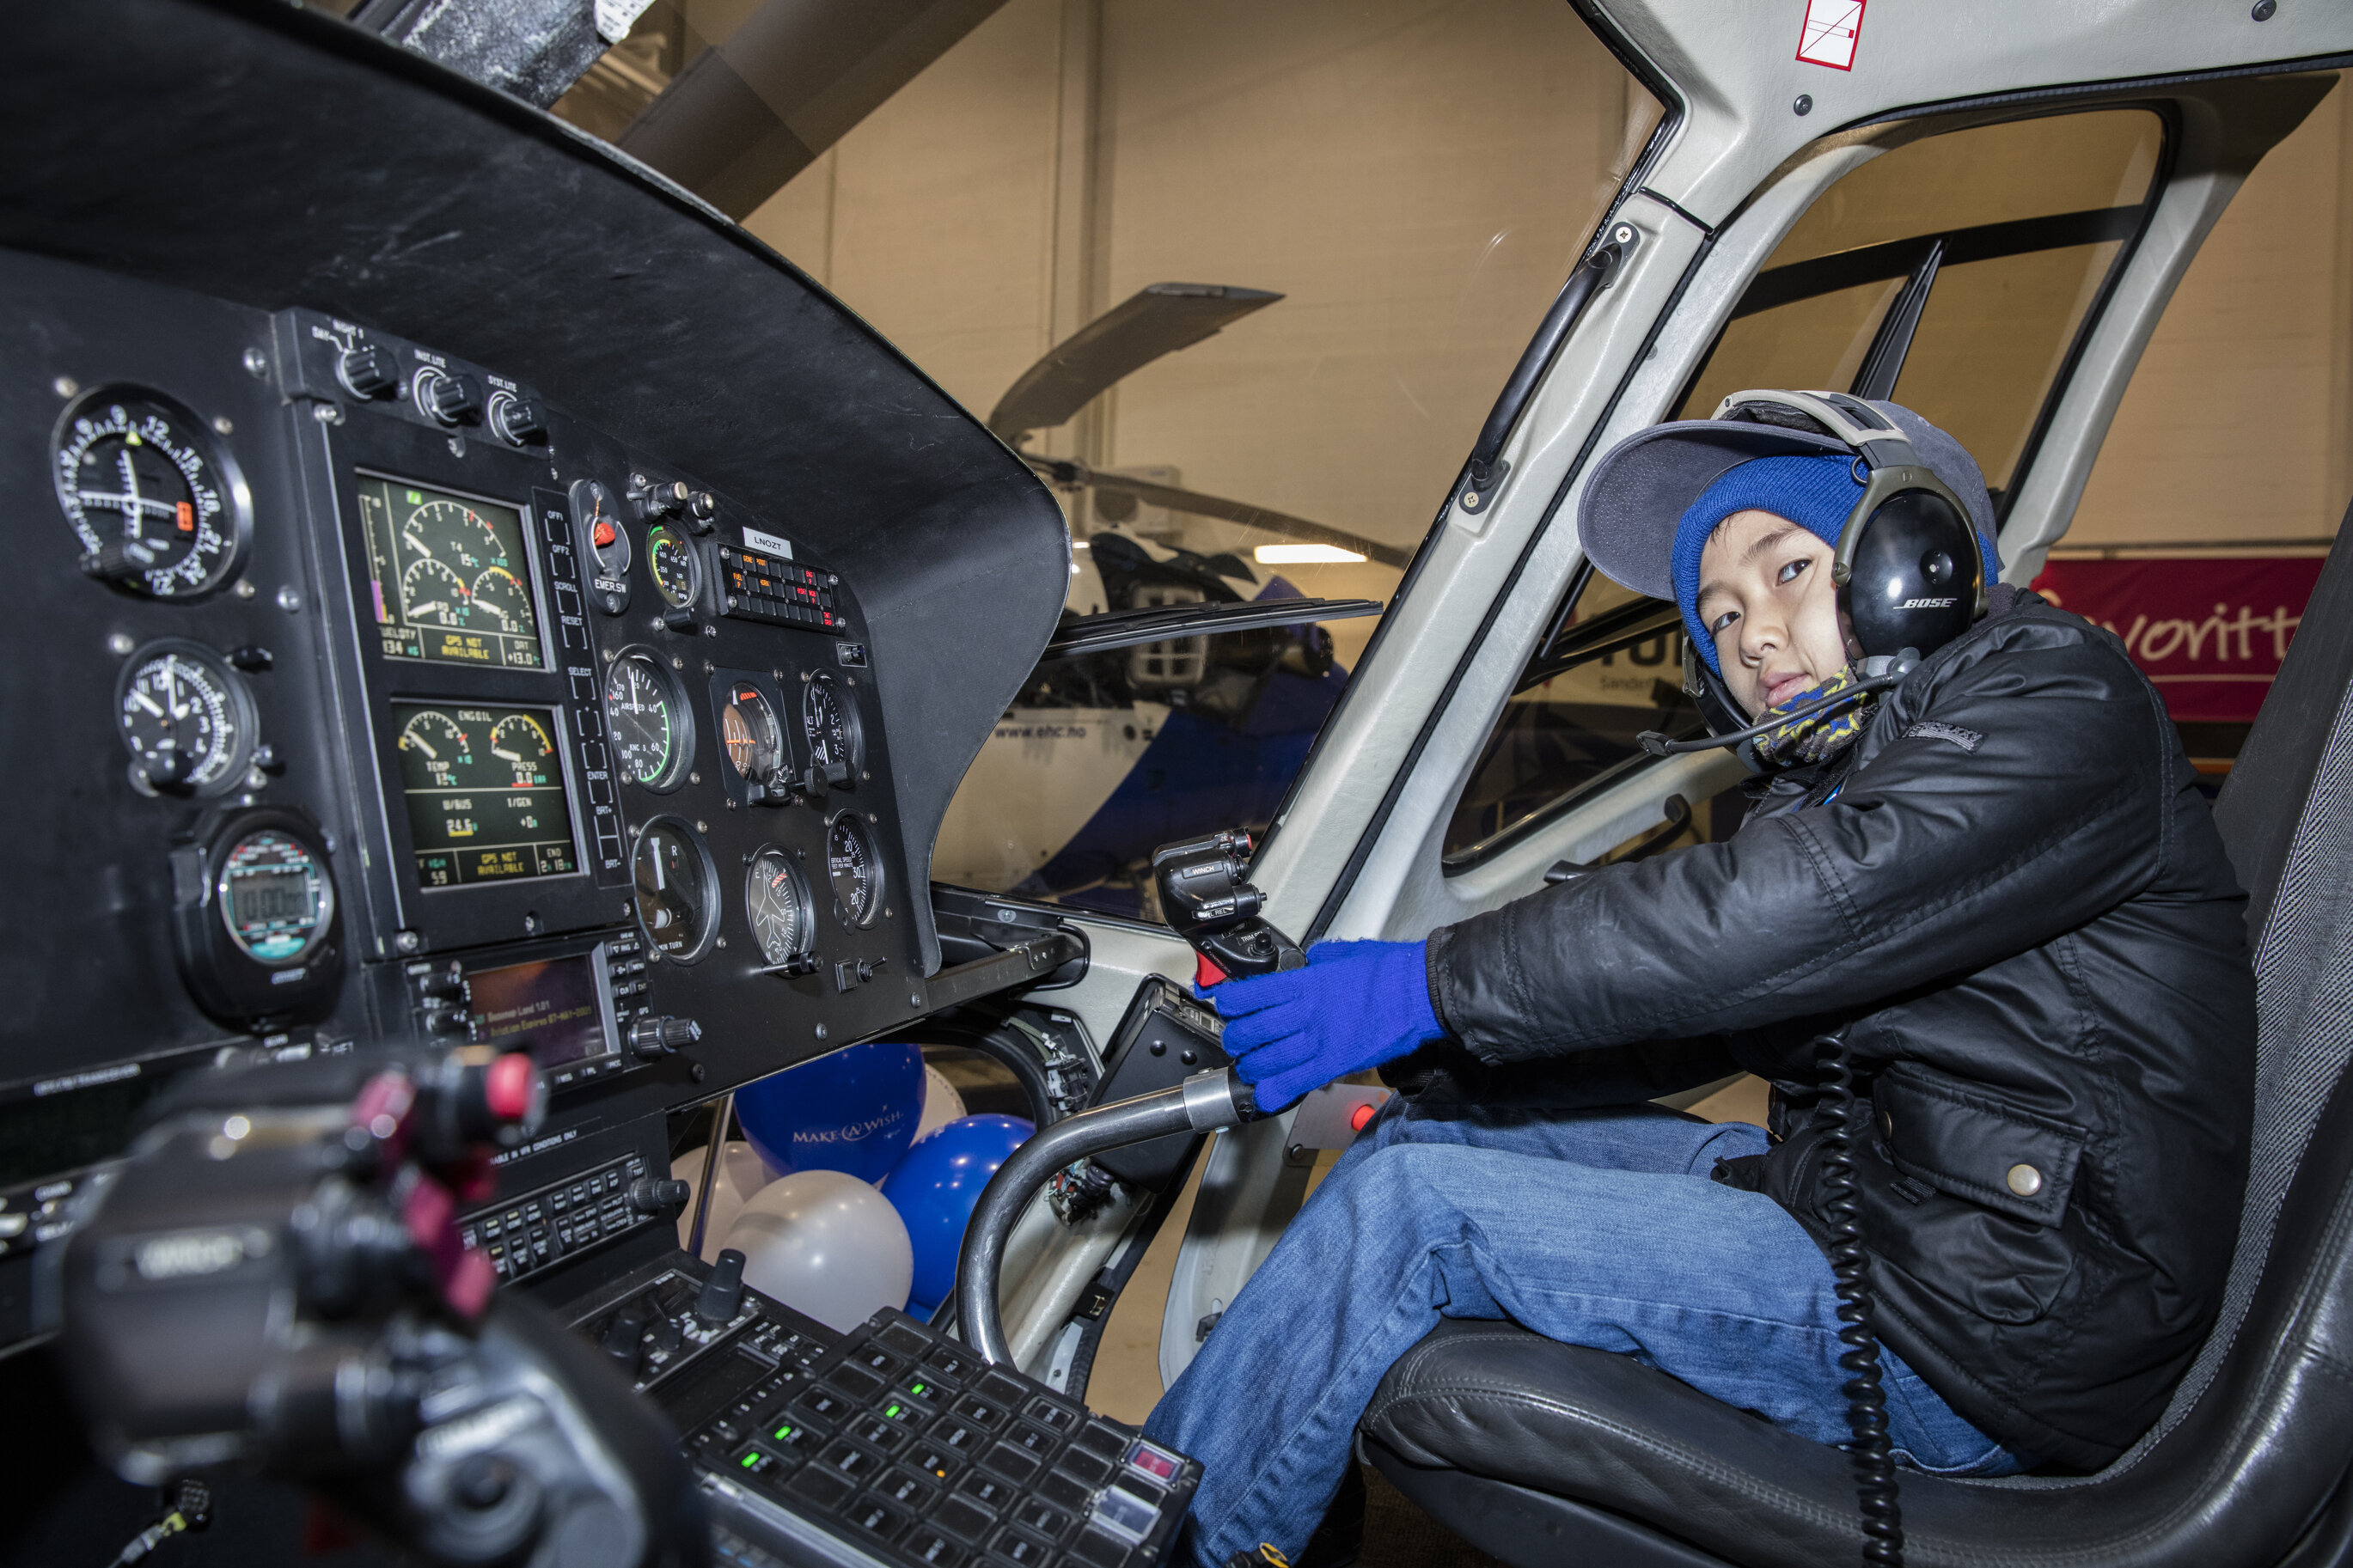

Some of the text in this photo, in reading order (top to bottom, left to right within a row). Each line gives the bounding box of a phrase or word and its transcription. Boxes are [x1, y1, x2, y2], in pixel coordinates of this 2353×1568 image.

[146, 416, 169, 436] 12
[754, 536, 782, 551] LNOZT
[552, 545, 570, 555] OFF2
[554, 581, 578, 593] SCROLL
[594, 578, 626, 594] EMER.SW
[1893, 598, 1958, 610] BOSE
[561, 615, 582, 625] RESET
[2038, 589, 2303, 662] voritt
[445, 635, 482, 649] GPS NOT
[441, 645, 490, 660] AVAILABLE
[568, 666, 591, 676] SELECT
[612, 691, 623, 700] 160
[190, 696, 202, 714] 2
[621, 703, 645, 711] AIRSPED
[648, 705, 657, 713] 40
[199, 716, 211, 734] 3
[830, 714, 834, 725] 2
[651, 742, 659, 751] 60
[834, 743, 840, 755] 3
[621, 750, 632, 759] 100
[426, 761, 449, 772] TEMP
[511, 761, 537, 772] PRESS
[635, 759, 643, 768] 80
[587, 771, 608, 780] ENTER
[671, 845, 678, 857] R
[845, 840, 852, 852] 20
[481, 851, 517, 864] GPS NOT
[477, 862, 524, 876] AVAILABLE
[853, 867, 861, 878] 30
[1192, 865, 1214, 876] WINCH
[851, 893, 859, 905] 20
[1241, 934, 1254, 943] TRIM
[669, 941, 682, 949] TURN
[521, 1017, 547, 1031] Expires
[519, 1145, 531, 1156] VFR
[533, 1134, 562, 1151] CONDITIONS
[563, 1129, 577, 1140] ONLY
